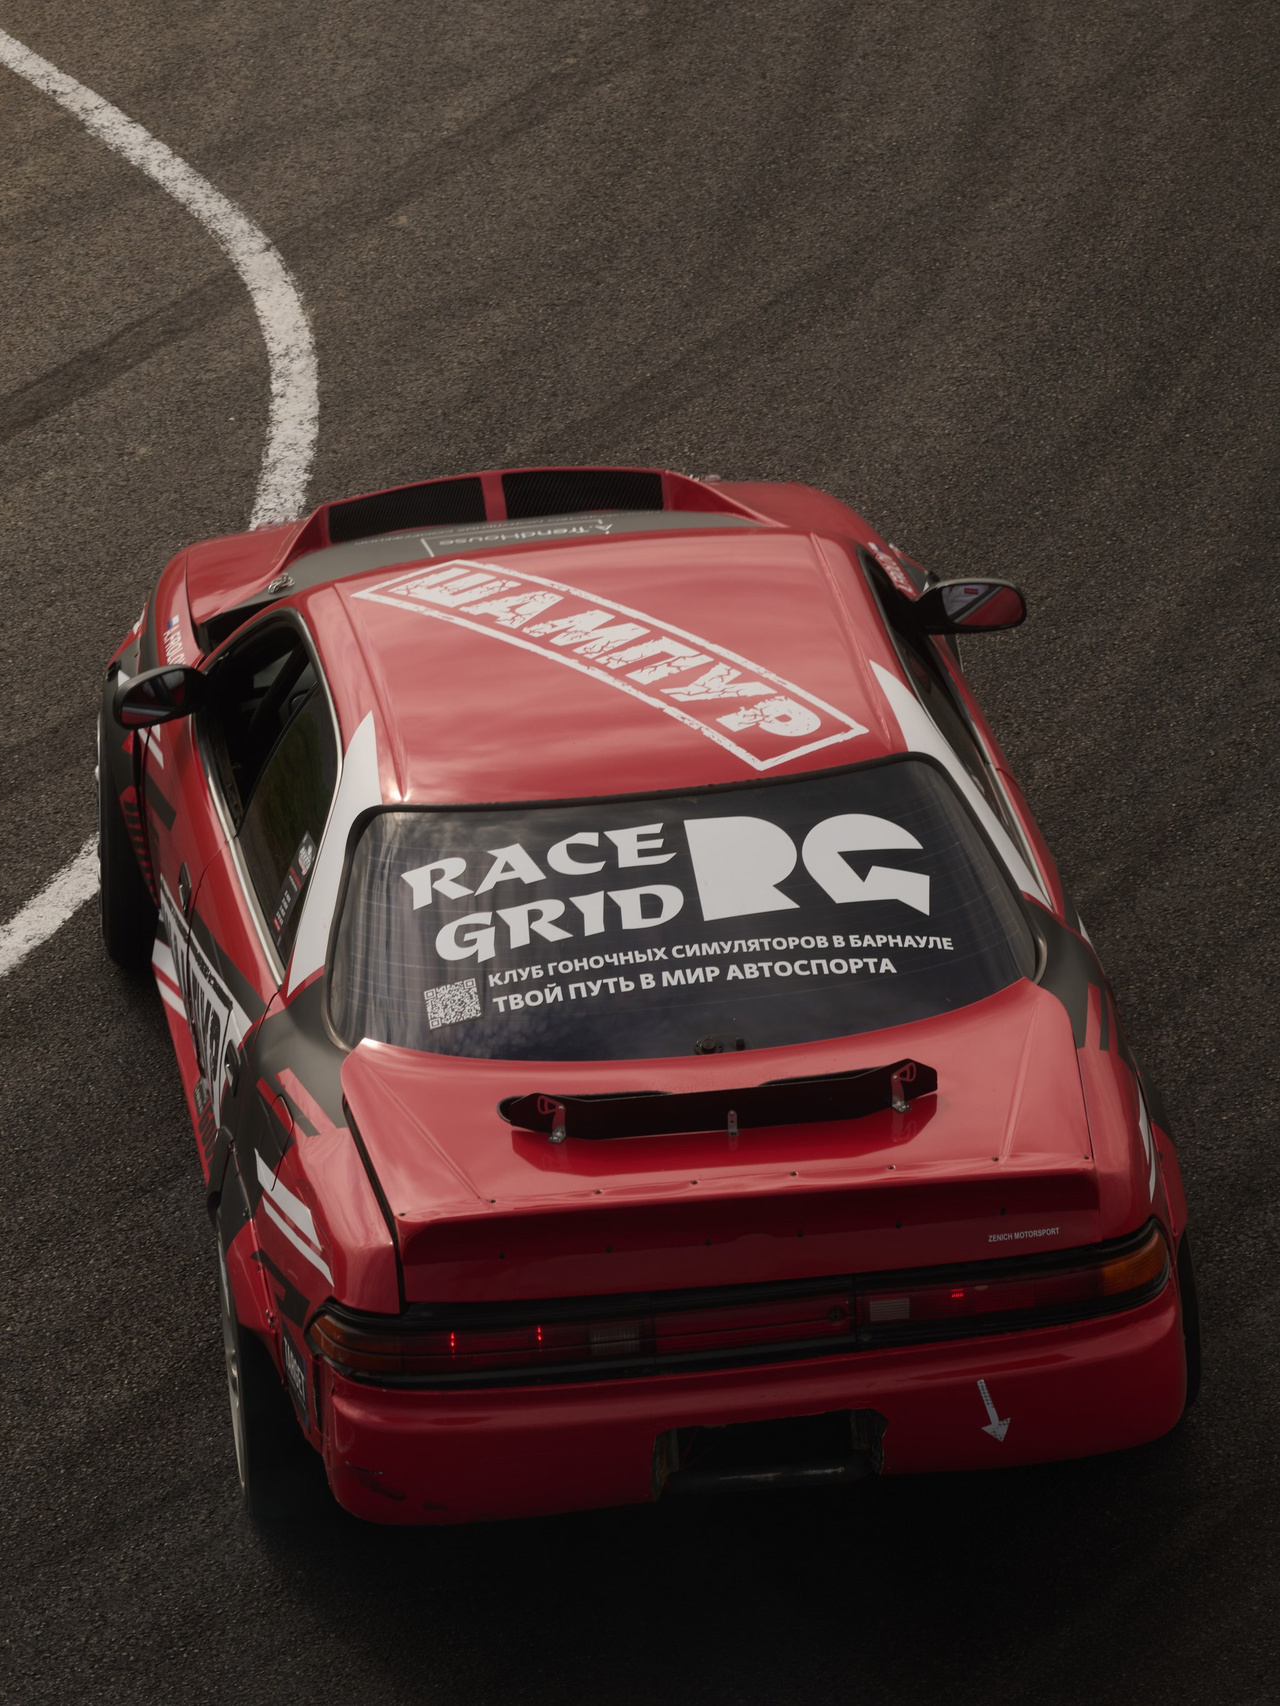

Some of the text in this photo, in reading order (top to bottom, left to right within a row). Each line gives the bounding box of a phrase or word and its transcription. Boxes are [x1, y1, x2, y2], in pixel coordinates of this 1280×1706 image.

[388, 567, 822, 737] ШАМПУР
[400, 822, 677, 911] RACE
[683, 812, 931, 922] RG
[435, 884, 685, 963] GRID
[487, 935, 954, 987] КЛУБ ГОНОЧНЫХ СИМУЛЯТОРОВ В БАРНАУЛЕ
[492, 957, 898, 1012] ТВОЙ ПУТЬ В МИР АВТОСПОРТА
[987, 1226, 1060, 1243] ZENICH MOTORSPORT
